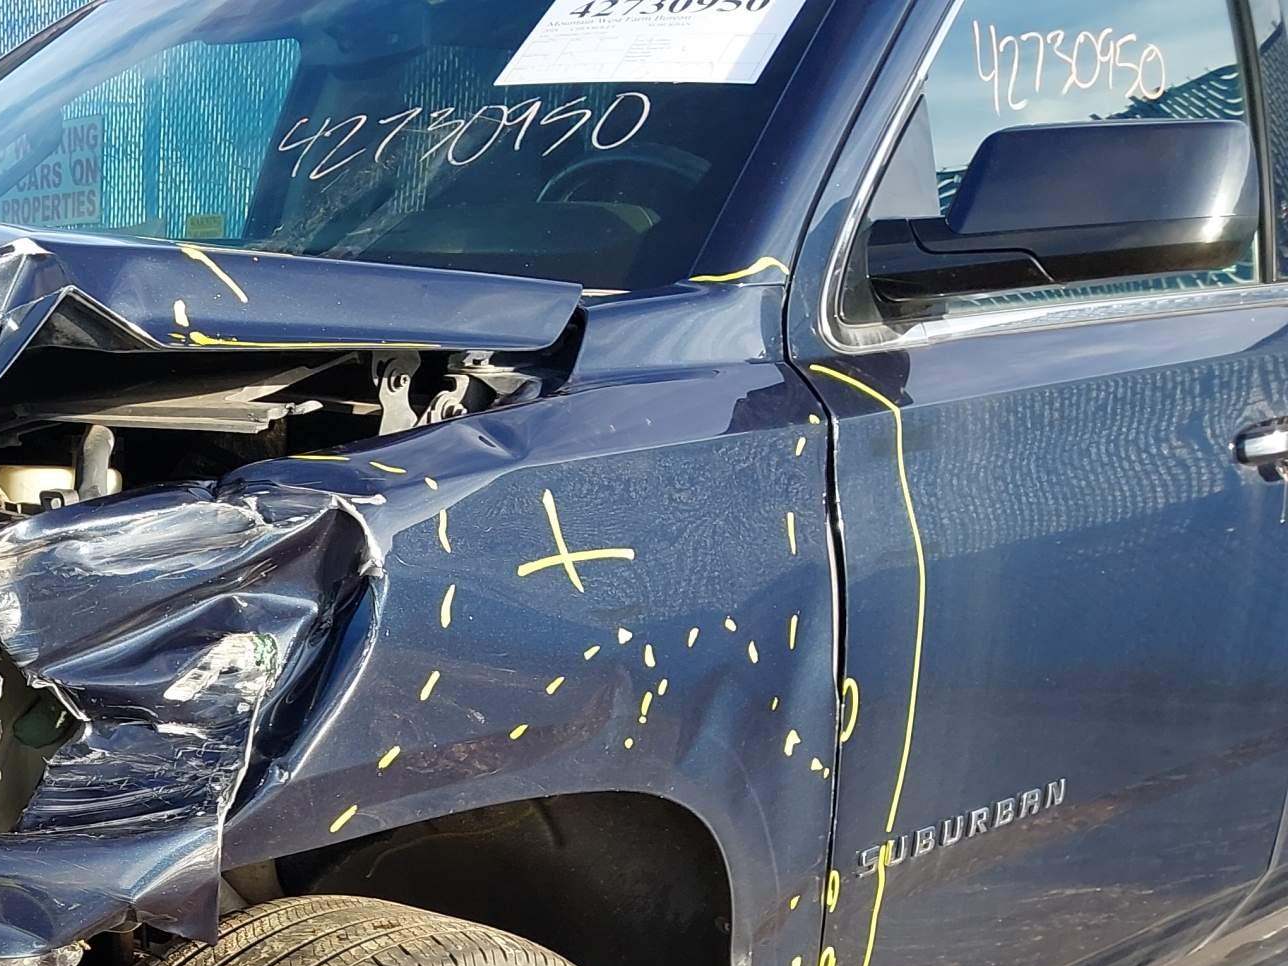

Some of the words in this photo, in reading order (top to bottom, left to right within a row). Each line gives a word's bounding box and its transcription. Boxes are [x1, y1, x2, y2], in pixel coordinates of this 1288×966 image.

[972, 20, 1166, 115] 42730950
[73, 158, 98, 187] ON
[278, 92, 650, 180] 42730950
[1, 189, 97, 224] PROPERTIES
[854, 778, 1067, 878] SUBURBAN
